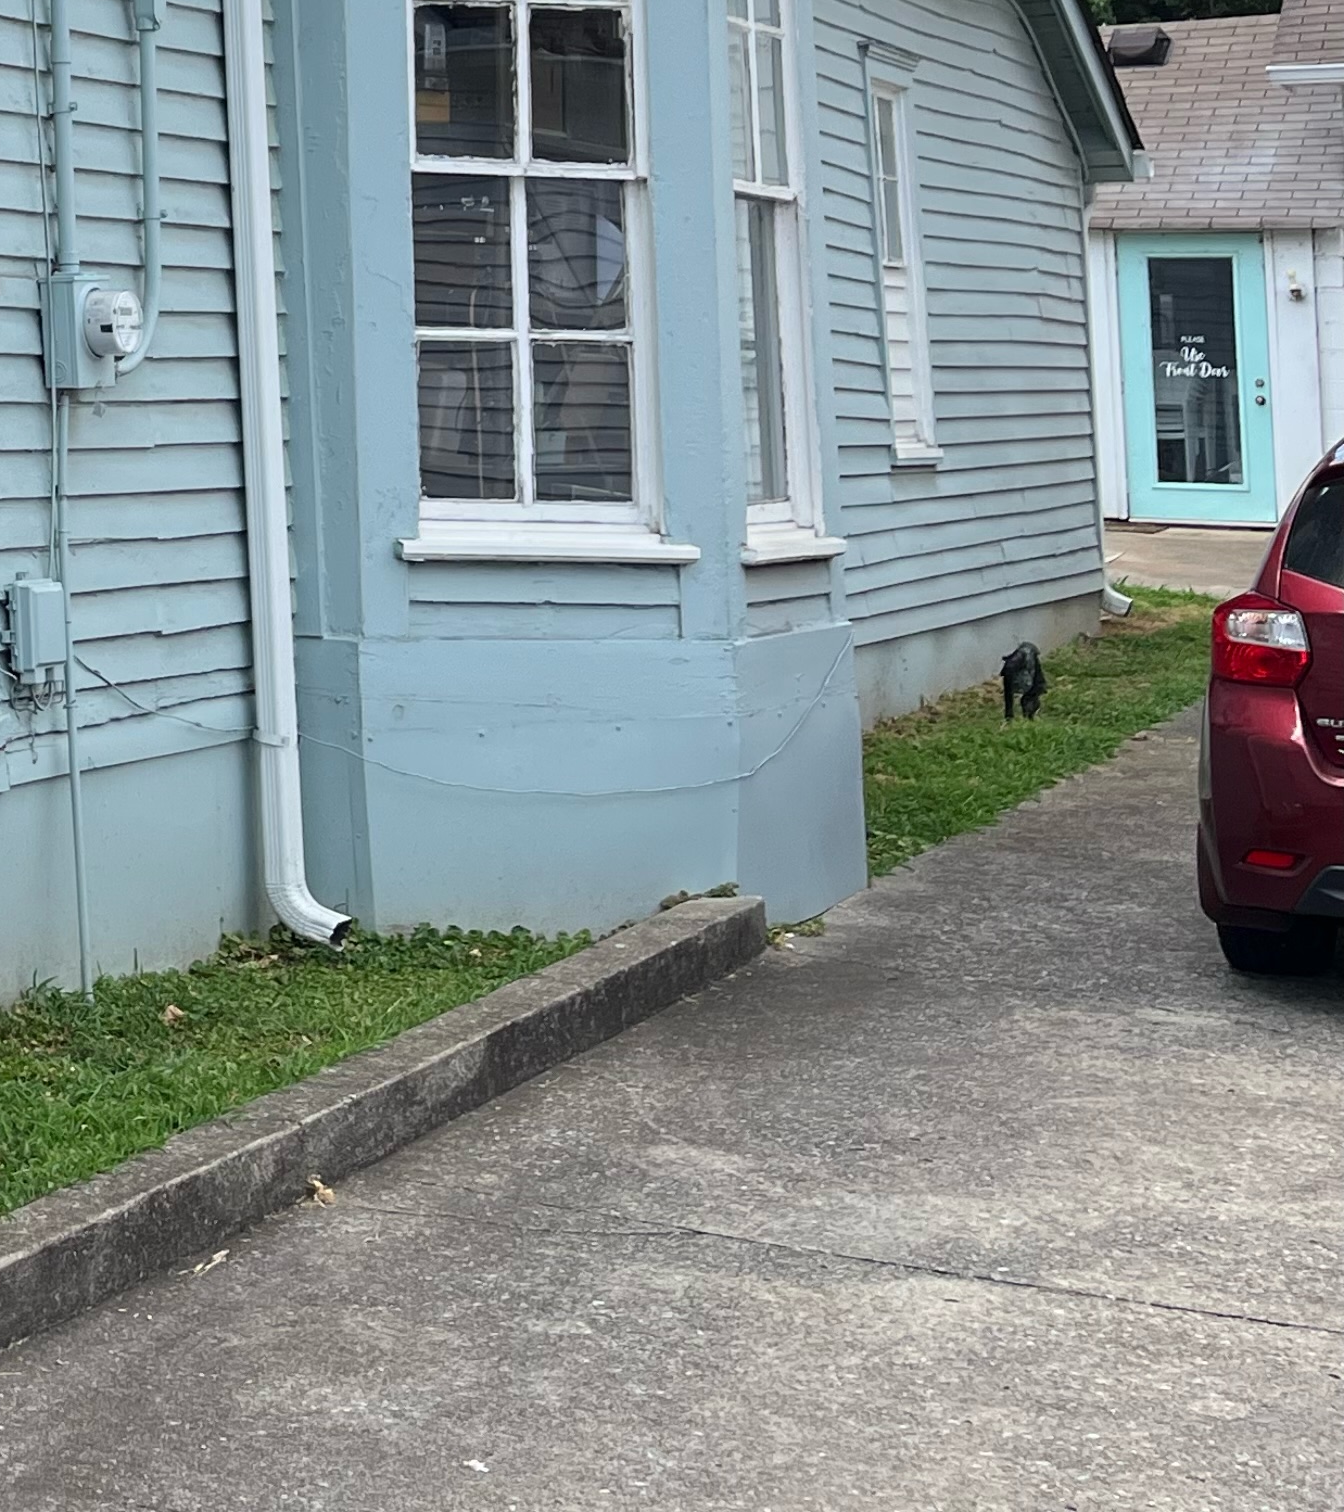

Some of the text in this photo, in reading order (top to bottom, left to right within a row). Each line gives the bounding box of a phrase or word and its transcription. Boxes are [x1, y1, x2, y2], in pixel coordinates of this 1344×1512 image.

[1179, 345, 1206, 363] Use
[1159, 361, 1230, 378] Front Door
